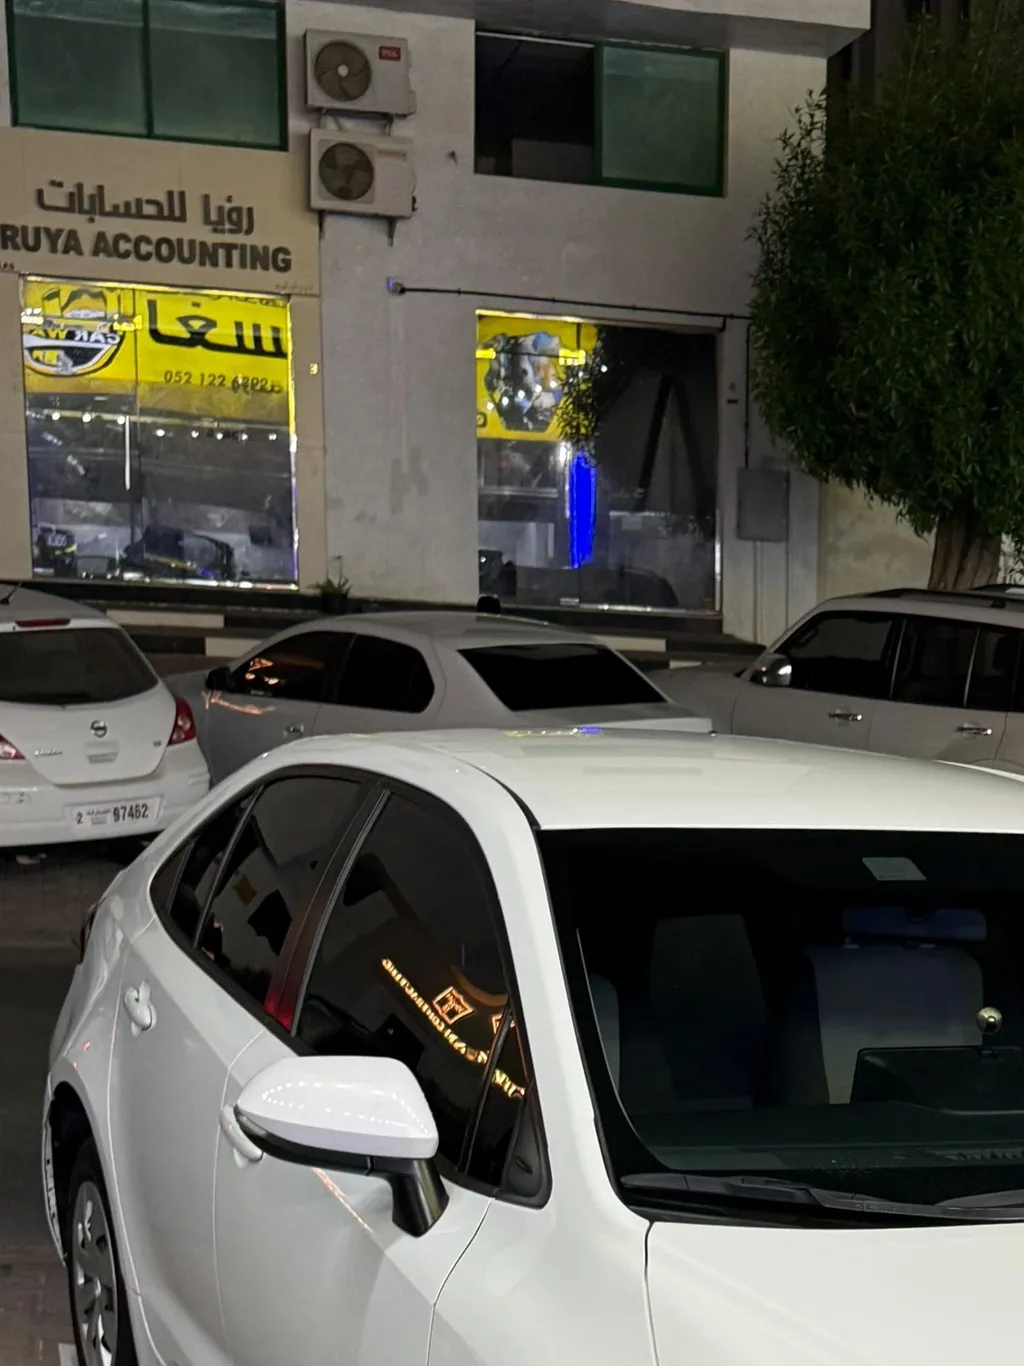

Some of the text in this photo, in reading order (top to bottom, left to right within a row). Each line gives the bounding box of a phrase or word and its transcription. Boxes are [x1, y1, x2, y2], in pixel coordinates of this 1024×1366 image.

[36, 179, 188, 224] للحسابات
[0, 223, 293, 273] RUYA ACCOUNTING
[163, 370, 193, 384] 052
[199, 372, 227, 387] 122
